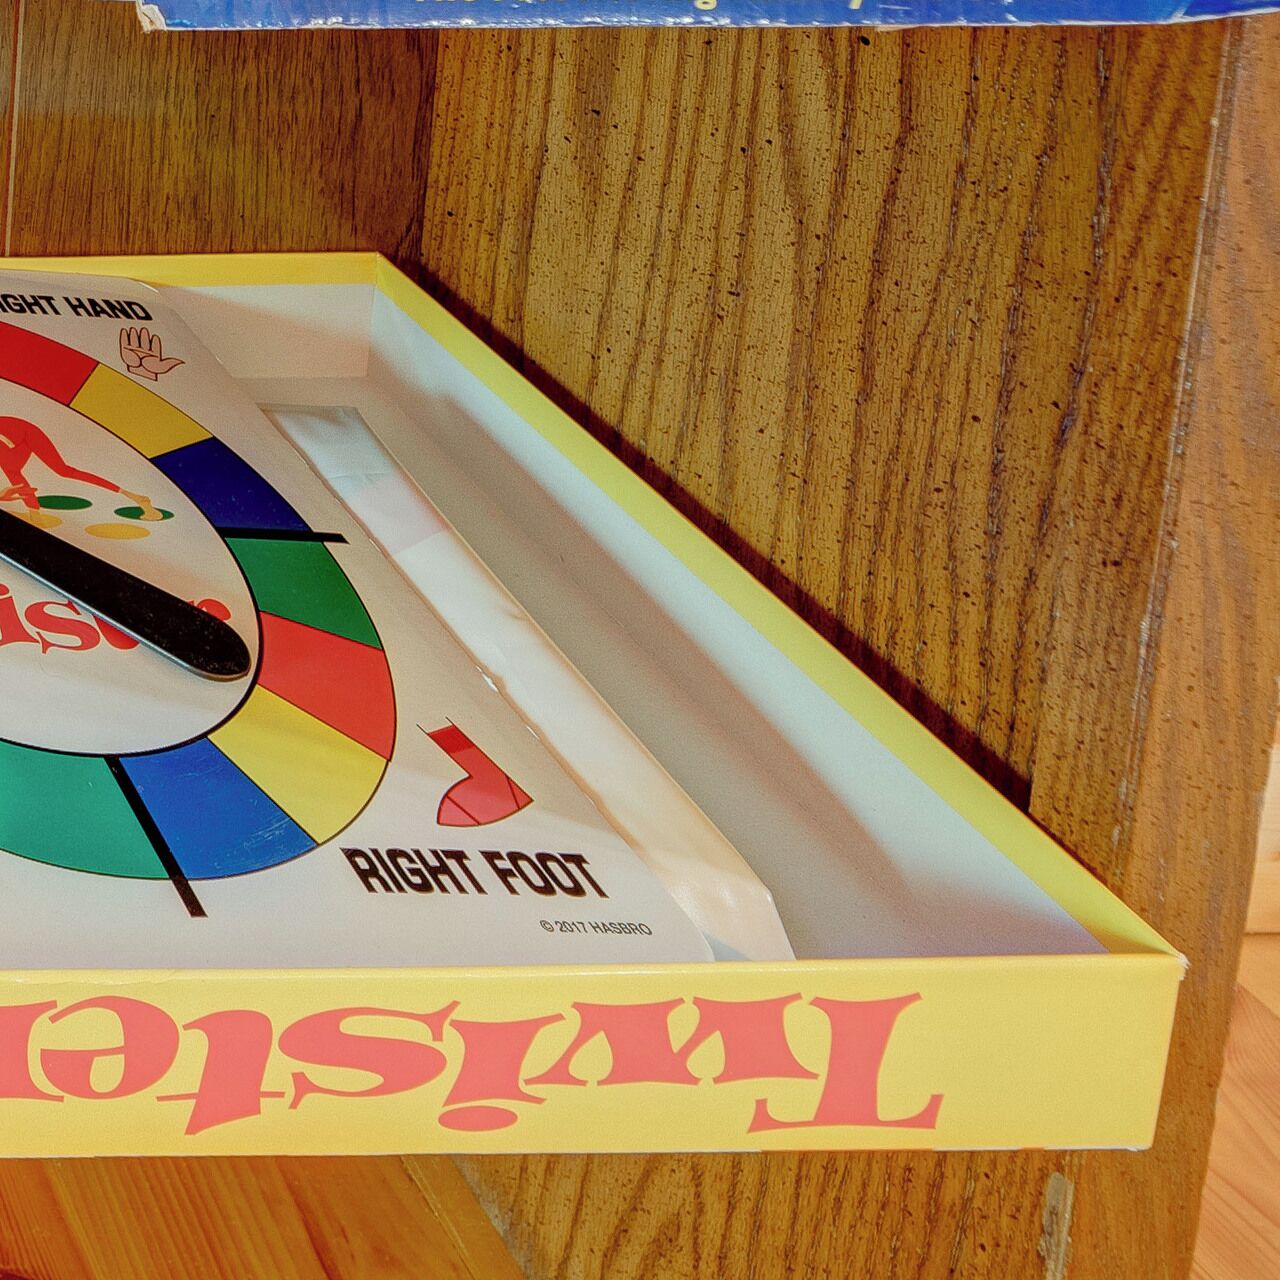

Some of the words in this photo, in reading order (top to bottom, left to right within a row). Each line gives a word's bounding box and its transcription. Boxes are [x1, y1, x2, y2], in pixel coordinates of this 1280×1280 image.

[70, 298, 155, 323] HAND
[340, 847, 480, 898] RIGHT
[480, 851, 610, 900] FOOT
[554, 920, 589, 937] 2017
[591, 922, 654, 937] HASBRO
